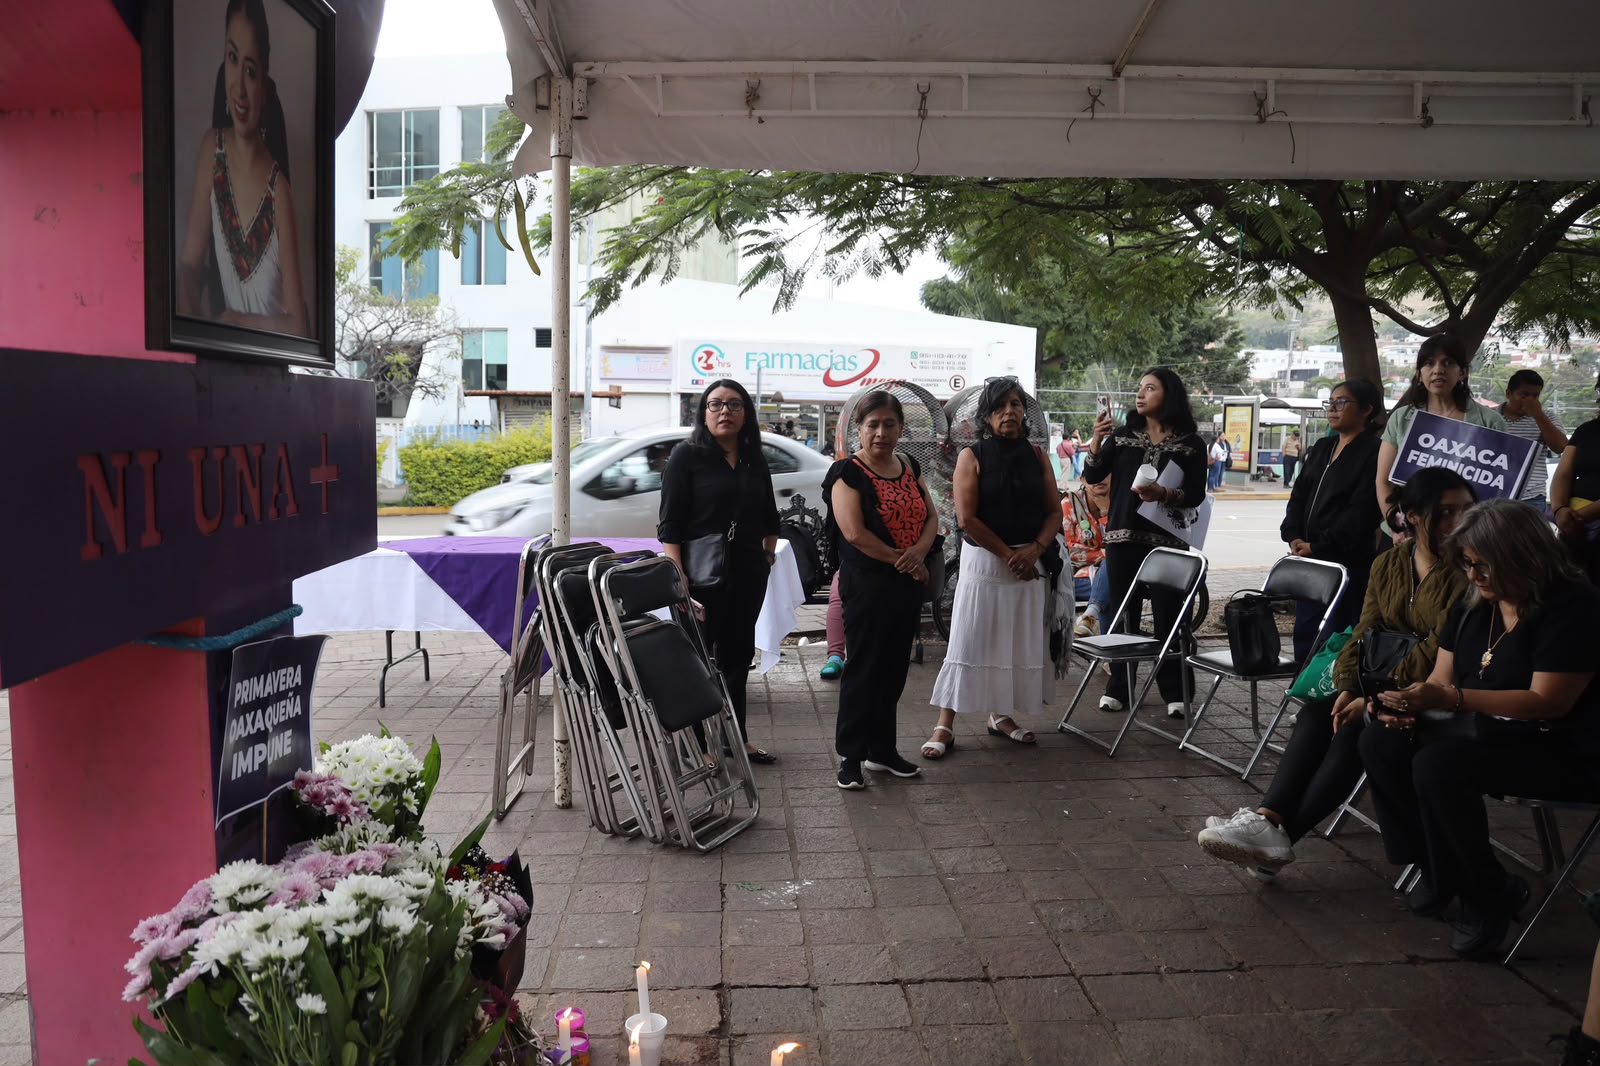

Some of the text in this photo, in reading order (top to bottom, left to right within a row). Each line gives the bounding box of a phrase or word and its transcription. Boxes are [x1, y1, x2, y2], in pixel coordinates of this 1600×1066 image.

[717, 359, 731, 368] hrs
[745, 349, 859, 372] Farmacias
[953, 378, 961, 388] E
[517, 399, 553, 408] IMPAR
[1417, 433, 1509, 471] OAXACA
[77, 449, 164, 561] NI
[187, 442, 299, 537] UNA
[233, 664, 302, 710] PRIMAVERA
[229, 692, 302, 743] OAXAQUEÑA
[231, 729, 292, 781] IMPUNE
